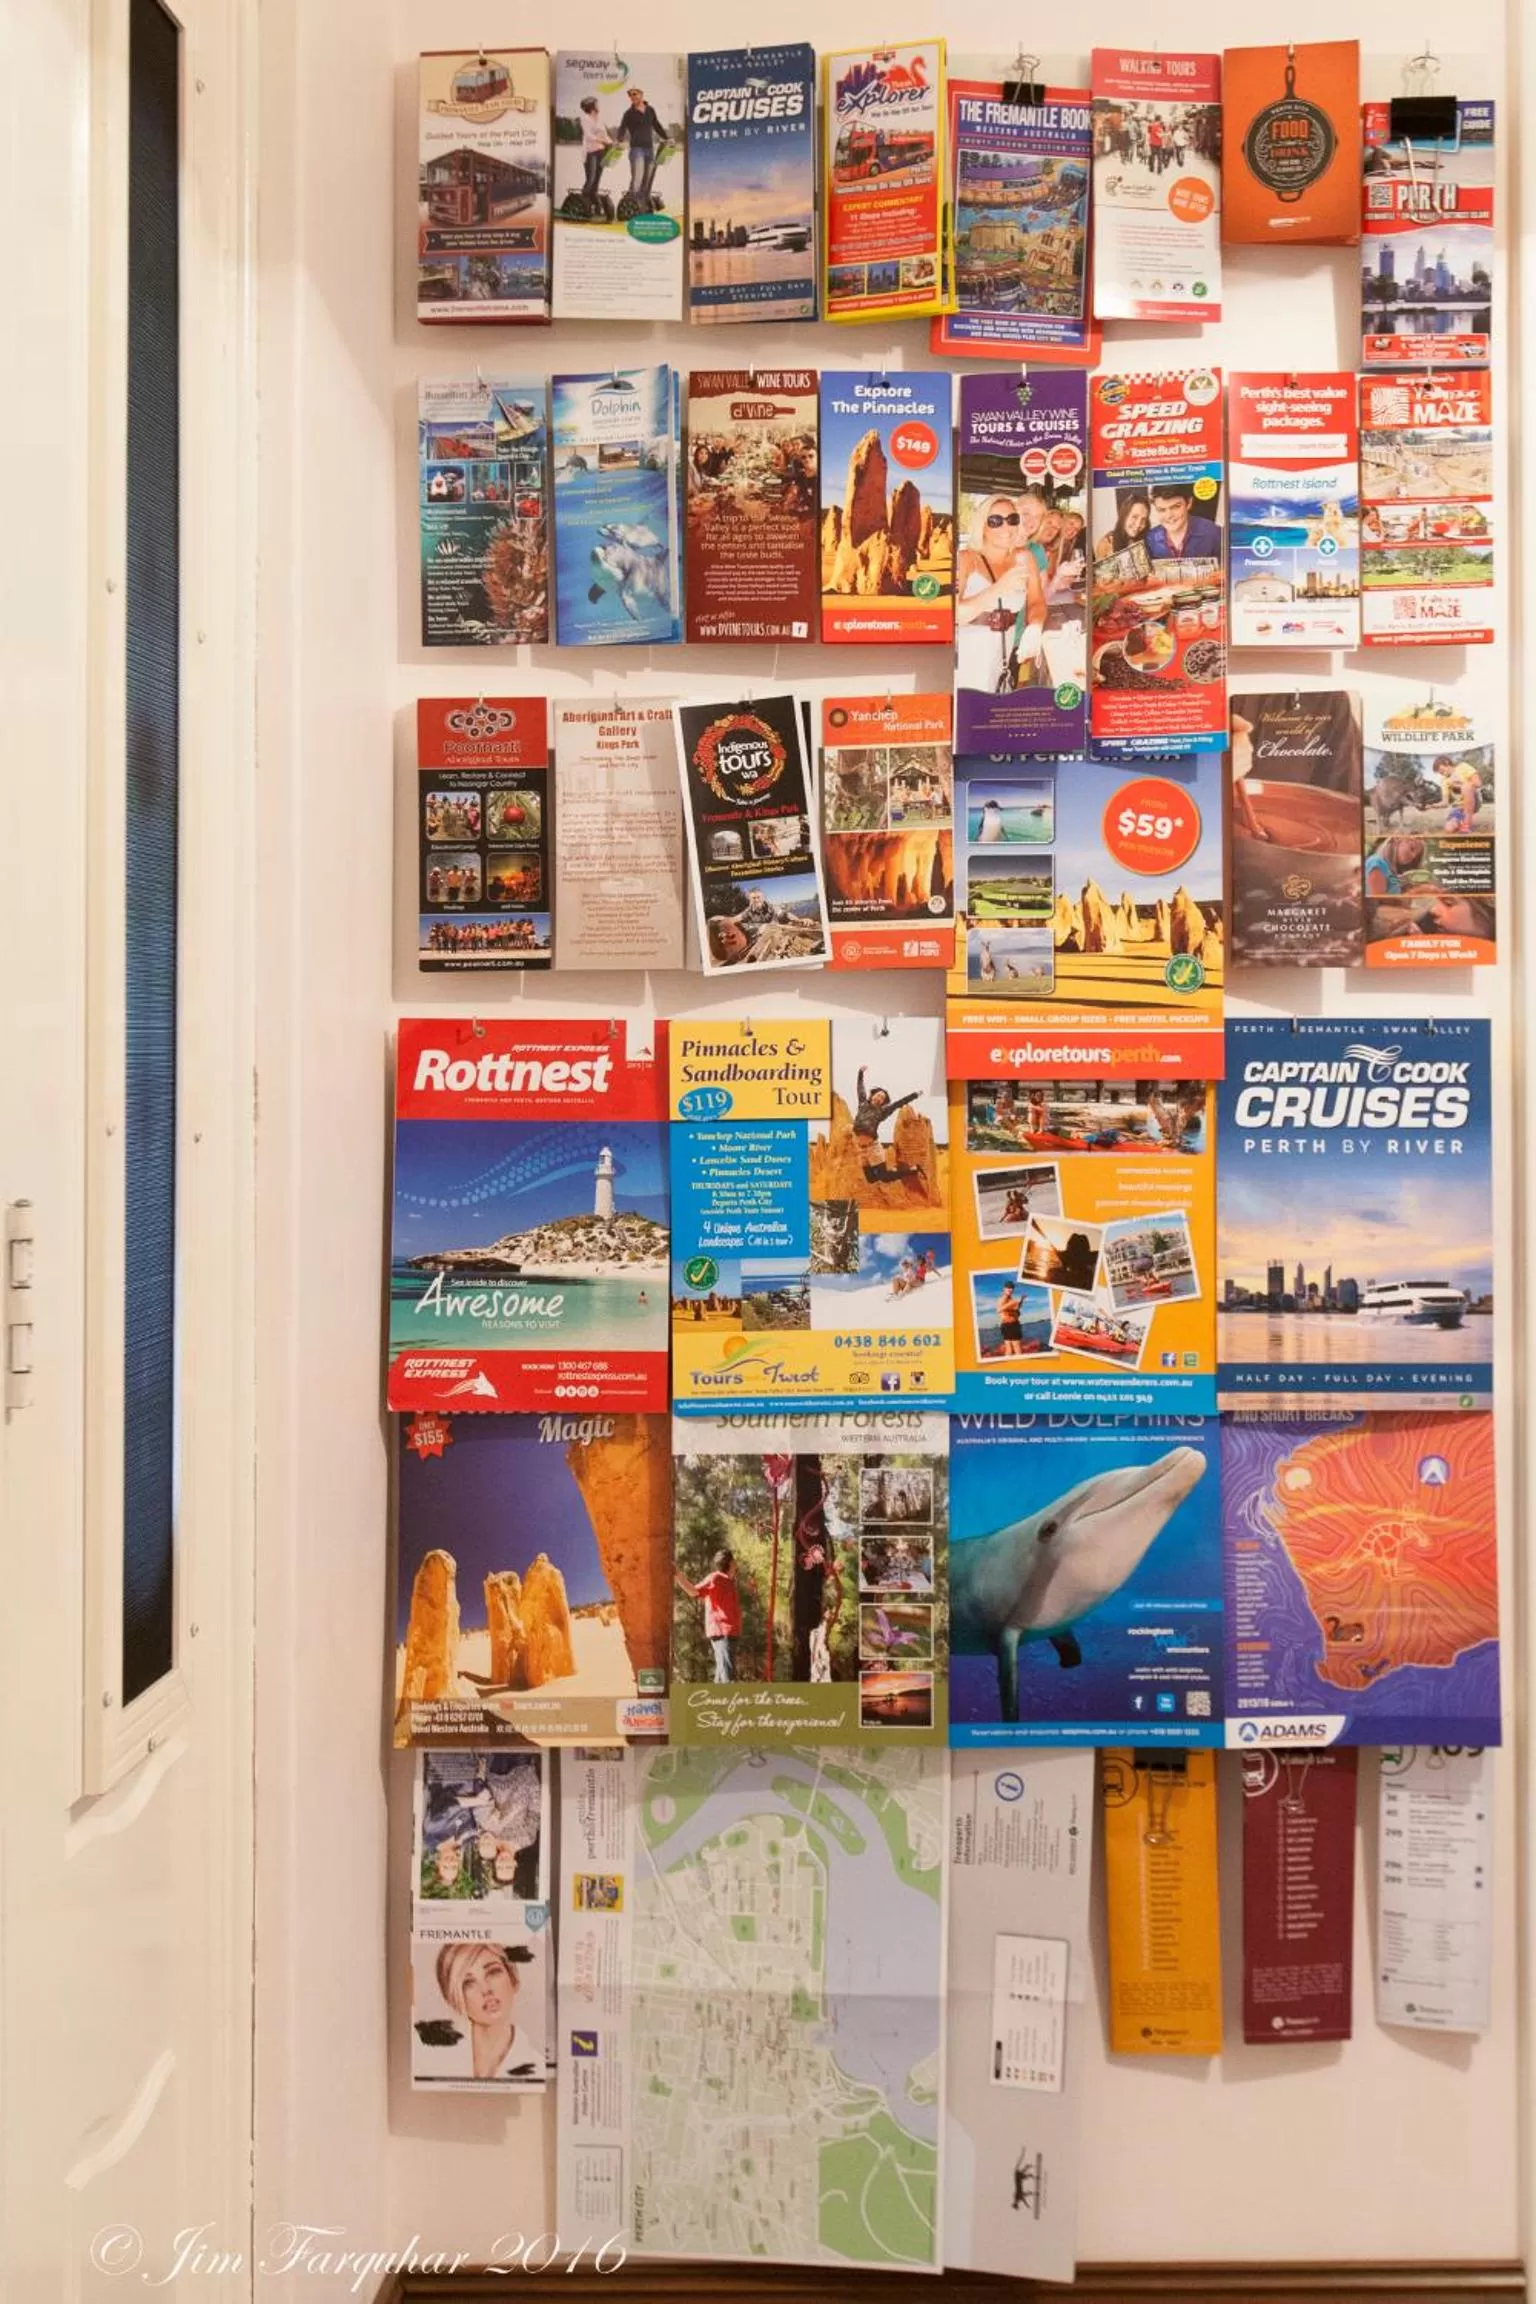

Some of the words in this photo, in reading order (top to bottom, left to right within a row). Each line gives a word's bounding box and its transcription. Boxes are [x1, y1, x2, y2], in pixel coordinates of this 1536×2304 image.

[565, 59, 610, 70] segway
[1119, 59, 1162, 74] WALKING
[1167, 61, 1196, 76] TOURS
[696, 88, 751, 101] CAPTAIN
[767, 82, 804, 96] COOK
[692, 95, 804, 123] CRUISES
[960, 100, 983, 122] THE
[986, 103, 1058, 127] FREMANTLE
[1464, 108, 1489, 117] FREE
[695, 127, 737, 140] PERTH
[767, 123, 806, 134] RIVER
[1271, 120, 1309, 139] FOOD
[697, 375, 724, 389] SWAN
[725, 375, 750, 388] VALLE
[757, 374, 782, 388] WINE
[783, 373, 810, 387] TOURS
[855, 386, 912, 398] Explore
[1240, 387, 1283, 399] Perth's
[1284, 387, 1309, 399] best
[1311, 388, 1347, 399] value
[591, 400, 641, 416] Dolphin
[733, 404, 774, 418] d'Vine
[832, 402, 859, 414] The
[863, 401, 934, 415] Pinnacles
[971, 410, 1004, 423] SWAN
[1006, 409, 1046, 422] VALLEY
[1047, 408, 1078, 418] WINE
[1118, 402, 1187, 420] SPEED
[1414, 403, 1481, 424] MAZE
[972, 422, 1012, 434] TOURS
[1016, 422, 1026, 432] &
[1029, 420, 1079, 432] CRUISES
[1101, 418, 1203, 439] GRAZING
[1262, 417, 1325, 429] packages.
[897, 436, 931, 454] $149
[1180, 444, 1207, 453] Tours
[1252, 478, 1299, 489] Rottnest
[1302, 477, 1337, 488] Island
[852, 711, 898, 723] Yanchep
[598, 725, 637, 737] Gallery
[883, 720, 921, 731] National
[923, 720, 944, 729] Park
[1381, 731, 1439, 742] WILDLIFE
[1442, 731, 1474, 741] PARK
[596, 740, 621, 750] Kings
[623, 740, 640, 749] Park
[718, 741, 768, 753] Indigenous
[1257, 737, 1333, 758] Chocolate.
[719, 751, 772, 774] tours
[741, 771, 758, 779] wa
[1267, 908, 1326, 917] MARGARET
[1263, 923, 1330, 933] CHOCOLATE
[1235, 1025, 1274, 1033] PERTH
[681, 1040, 778, 1057] Pinnacles
[787, 1039, 805, 1055] &
[414, 1049, 613, 1092] Rottnest
[681, 1064, 822, 1085] Sandboarding
[1244, 1062, 1360, 1082] CAPTAIN
[1393, 1063, 1470, 1083] COOK
[682, 1091, 727, 1113] $119
[773, 1087, 822, 1105] Tour
[1235, 1087, 1470, 1128] CRUISES
[1244, 1139, 1326, 1153] PERTH
[1343, 1140, 1372, 1153] BY
[1387, 1140, 1463, 1153] RIVER
[703, 1222, 711, 1233] 4
[415, 1271, 564, 1317] Awesome
[835, 1336, 872, 1348] 0438
[878, 1335, 906, 1347] 846
[913, 1335, 941, 1347] 602
[405, 1359, 477, 1368] ROTTNEST
[404, 1369, 468, 1379] EXPRESS
[690, 1371, 743, 1385] Tours
[985, 1376, 1008, 1385] Book
[1009, 1378, 1029, 1387] your
[1031, 1377, 1050, 1385] tour
[1052, 1377, 1060, 1385] at
[1279, 1374, 1304, 1382] DAY
[1367, 1374, 1392, 1382] DAY
[1412, 1374, 1472, 1382] EVENING
[840, 1412, 924, 1428] Forests
[959, 1414, 1036, 1429] WILD
[1050, 1413, 1206, 1428] DOLPHINS
[538, 1415, 615, 1446] Magic
[414, 1431, 444, 1446] $155
[688, 1690, 728, 1707] Come
[696, 1711, 730, 1735] Stay
[1261, 1723, 1327, 1738] ADAMS
[420, 1930, 492, 1939] FREMANTLE
